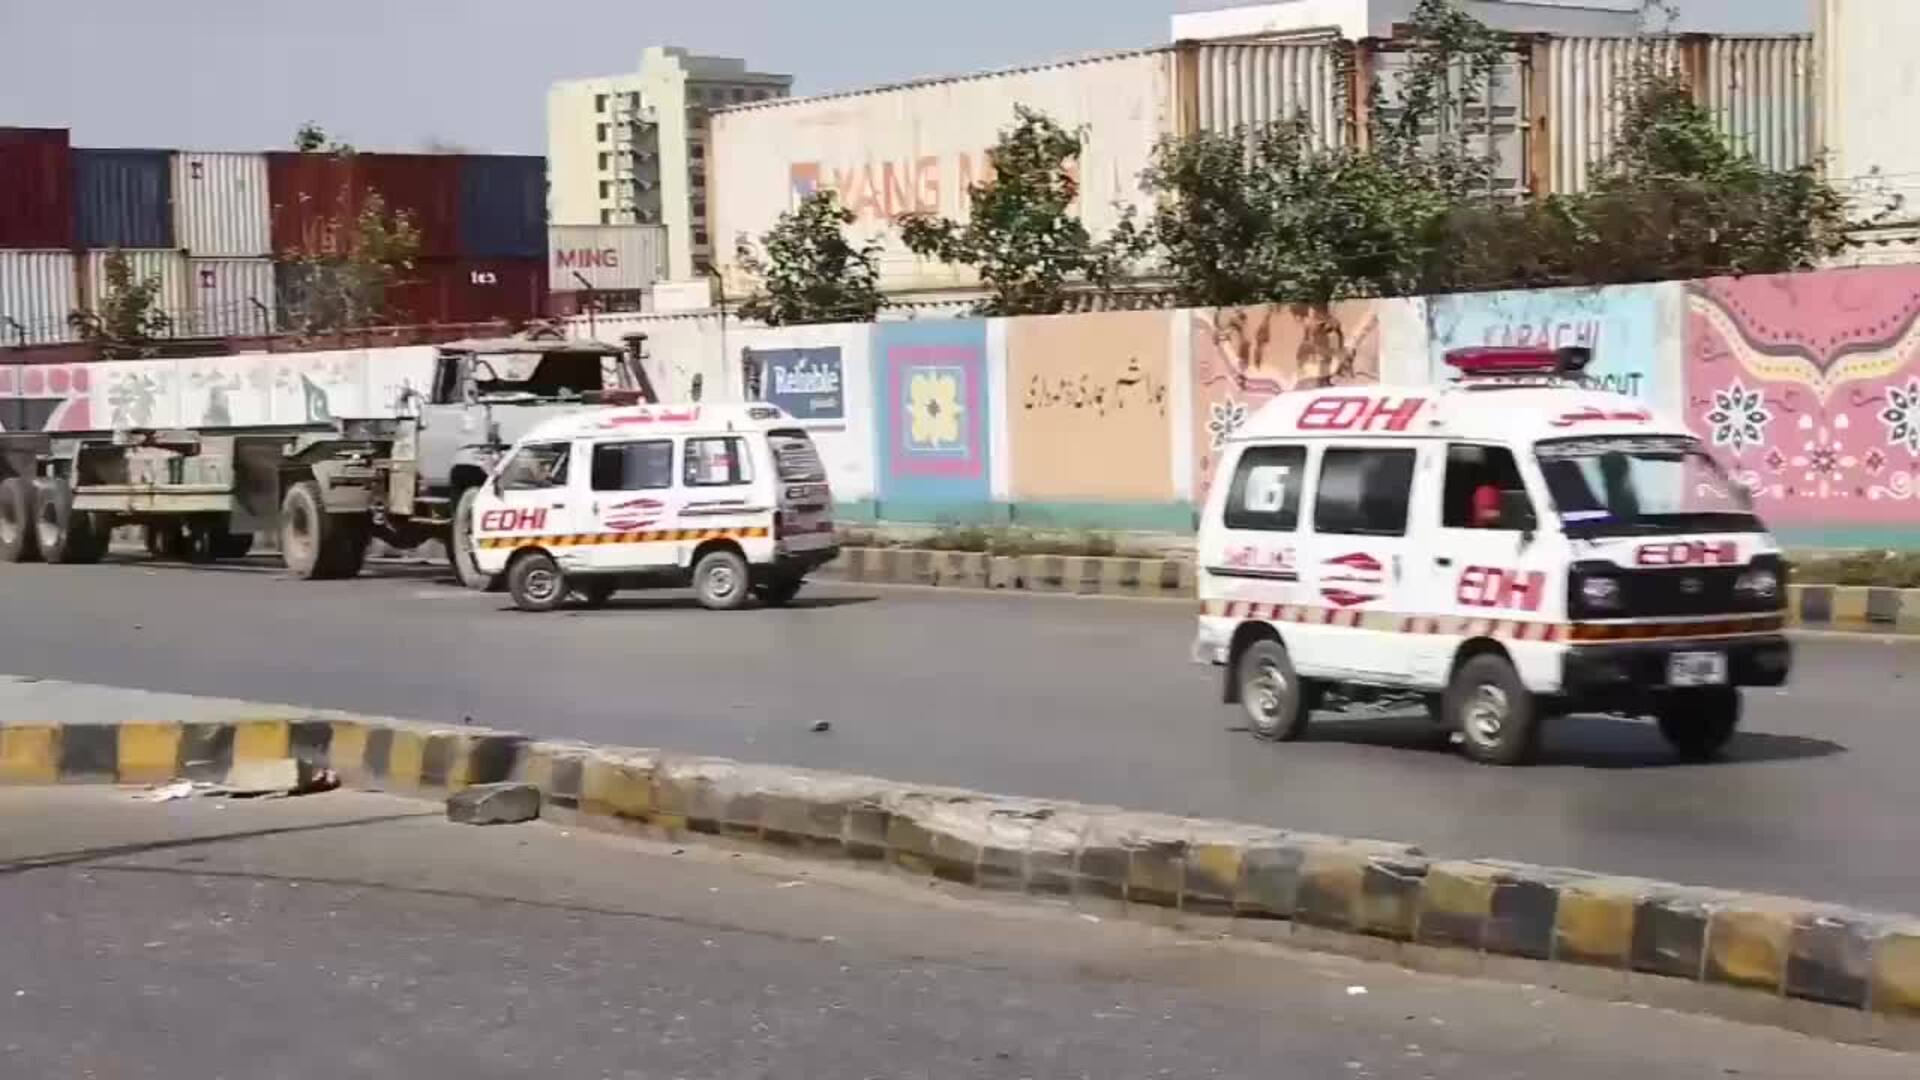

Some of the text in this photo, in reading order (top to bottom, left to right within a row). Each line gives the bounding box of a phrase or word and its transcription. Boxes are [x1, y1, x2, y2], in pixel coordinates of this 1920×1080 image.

[556, 248, 618, 269] MING
[1296, 396, 1428, 431] EDHI
[480, 508, 548, 532] EDHI
[1634, 541, 1738, 566] EDHI
[1456, 564, 1548, 612] EDHI
